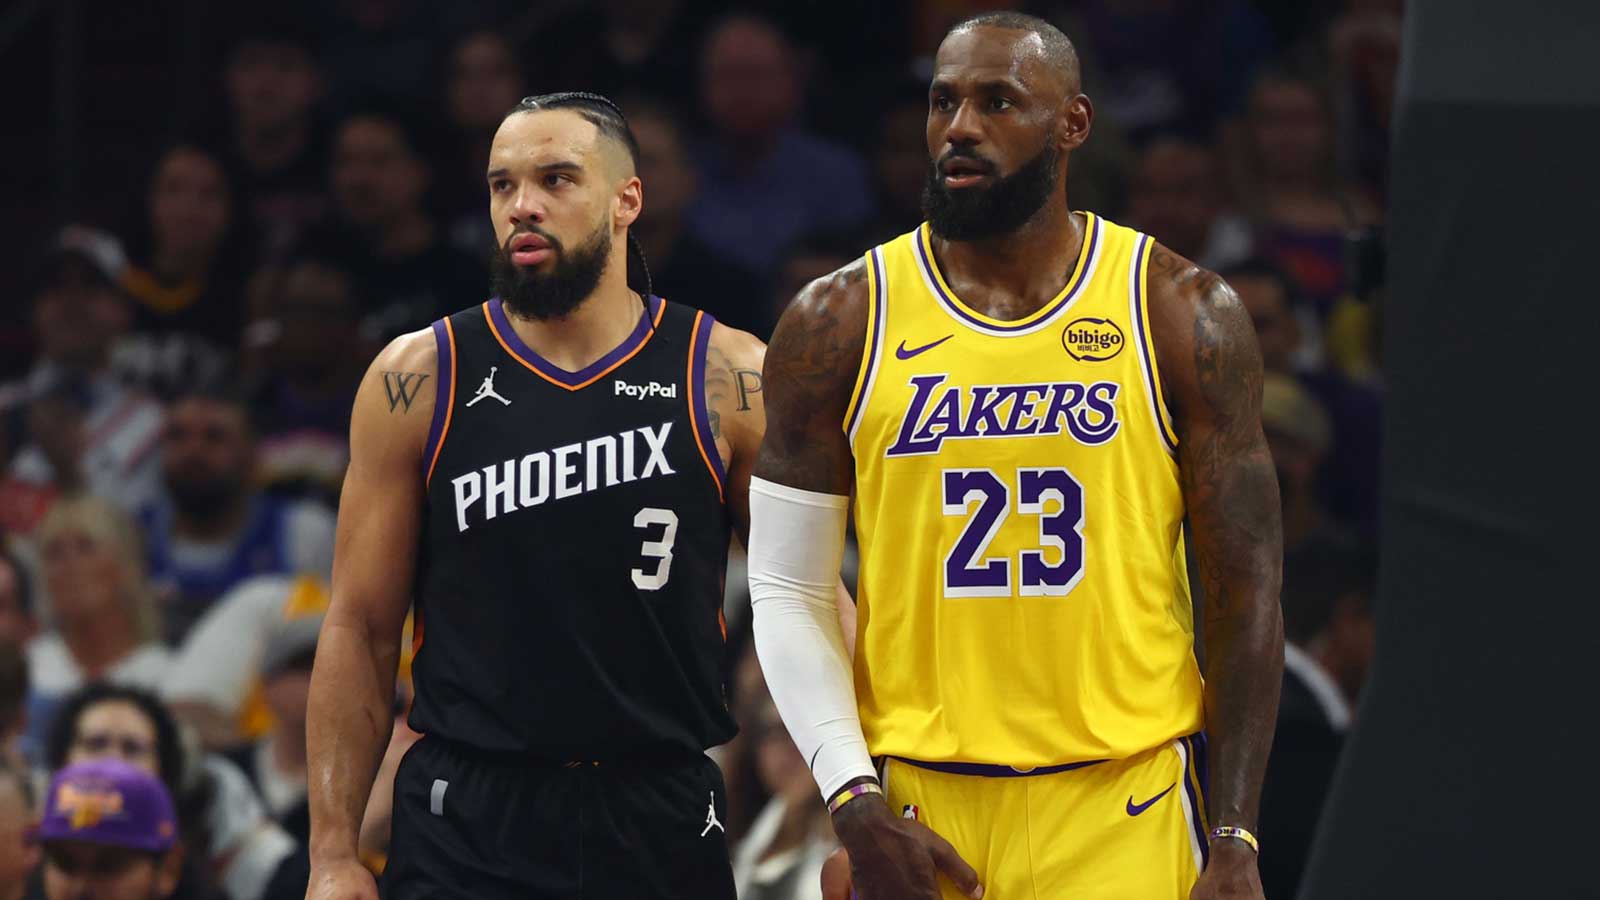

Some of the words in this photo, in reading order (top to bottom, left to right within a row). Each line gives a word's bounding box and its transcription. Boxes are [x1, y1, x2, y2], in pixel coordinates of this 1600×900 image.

[1068, 329, 1121, 349] bibigo
[380, 371, 430, 414] W
[614, 380, 677, 401] PayPal
[885, 373, 1120, 458] LAKERS
[451, 421, 676, 532] PHOENIX
[631, 507, 679, 591] 3
[942, 467, 1085, 598] 23
